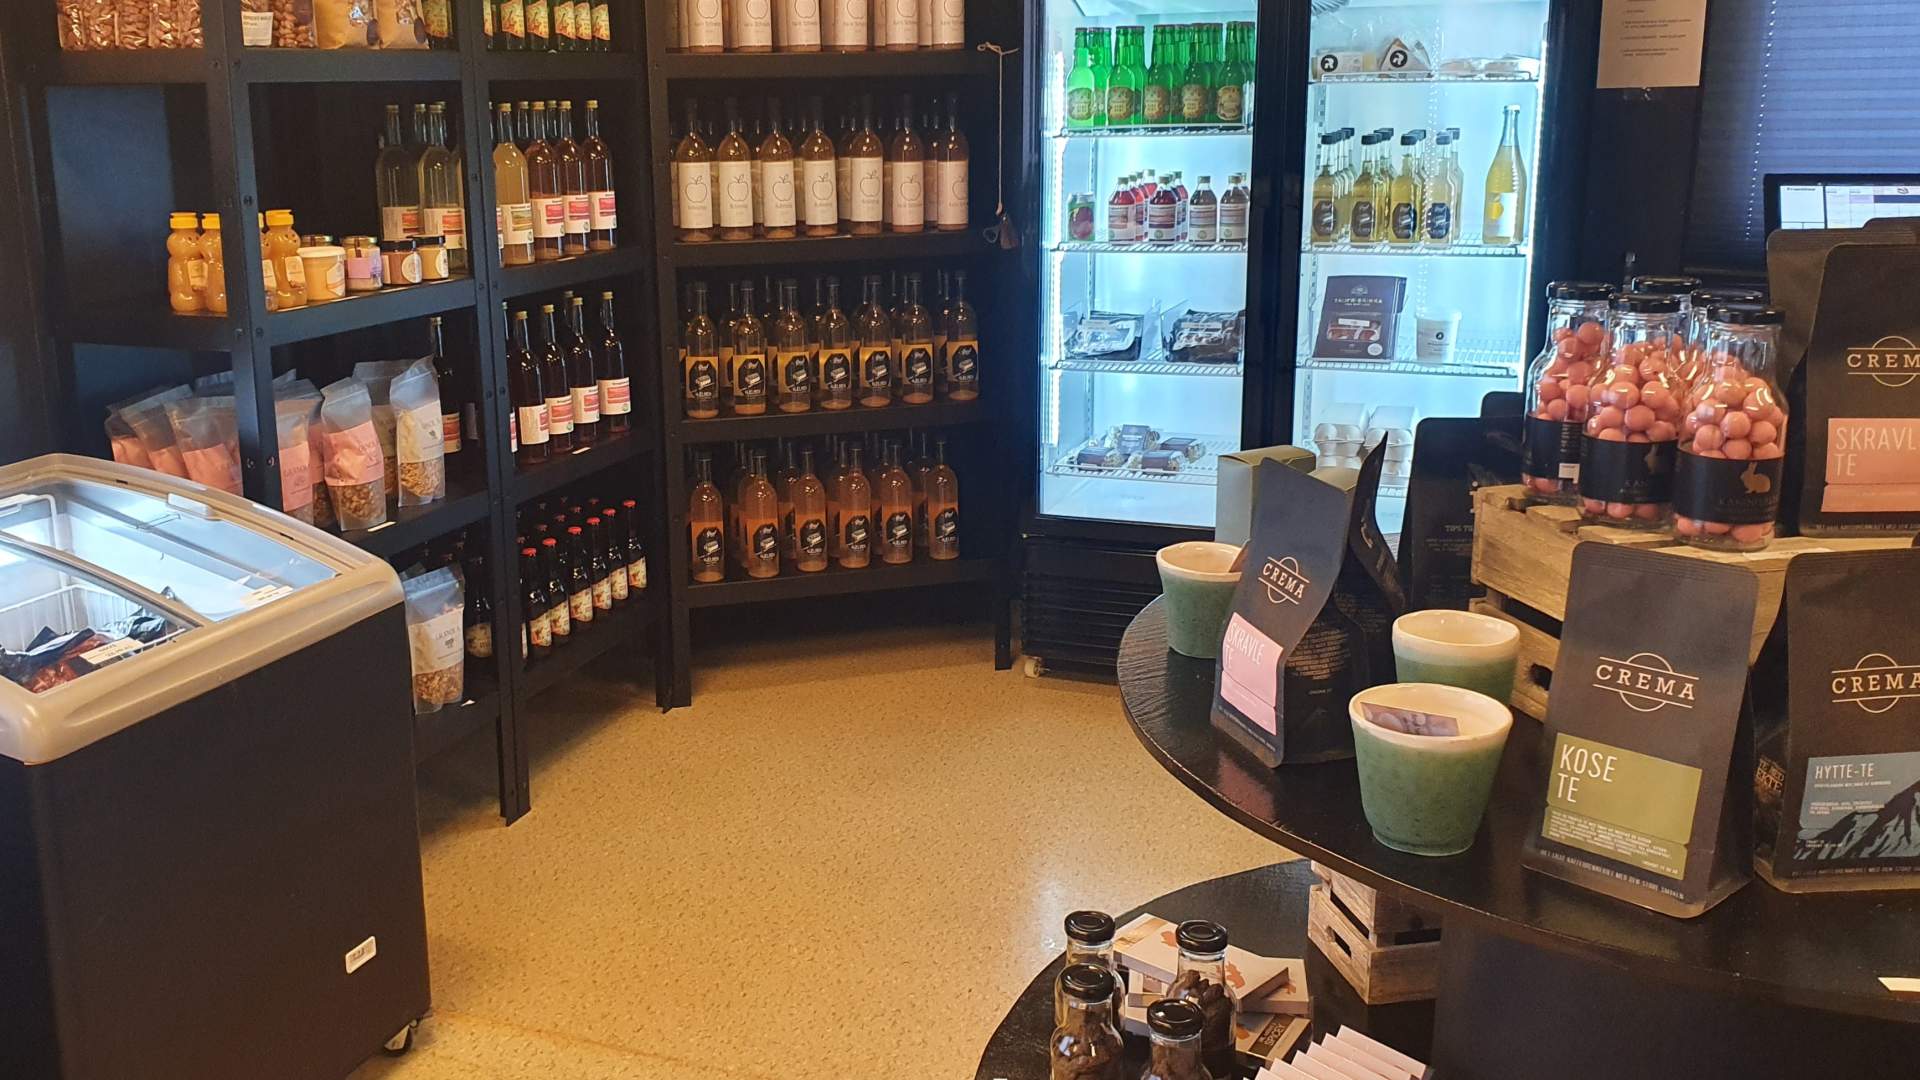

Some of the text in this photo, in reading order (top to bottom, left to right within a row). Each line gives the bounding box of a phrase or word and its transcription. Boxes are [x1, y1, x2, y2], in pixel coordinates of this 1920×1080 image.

[1834, 452, 1858, 477] TE
[1262, 560, 1305, 600] CREMA
[1224, 644, 1236, 670] TE
[1226, 621, 1266, 665] SKRAVLE
[1595, 664, 1697, 702] CREMA
[1831, 672, 1920, 694] CREMA
[1559, 743, 1618, 784] KOSE
[1814, 762, 1875, 780] HYTTE-TE
[1556, 771, 1580, 804] TE
